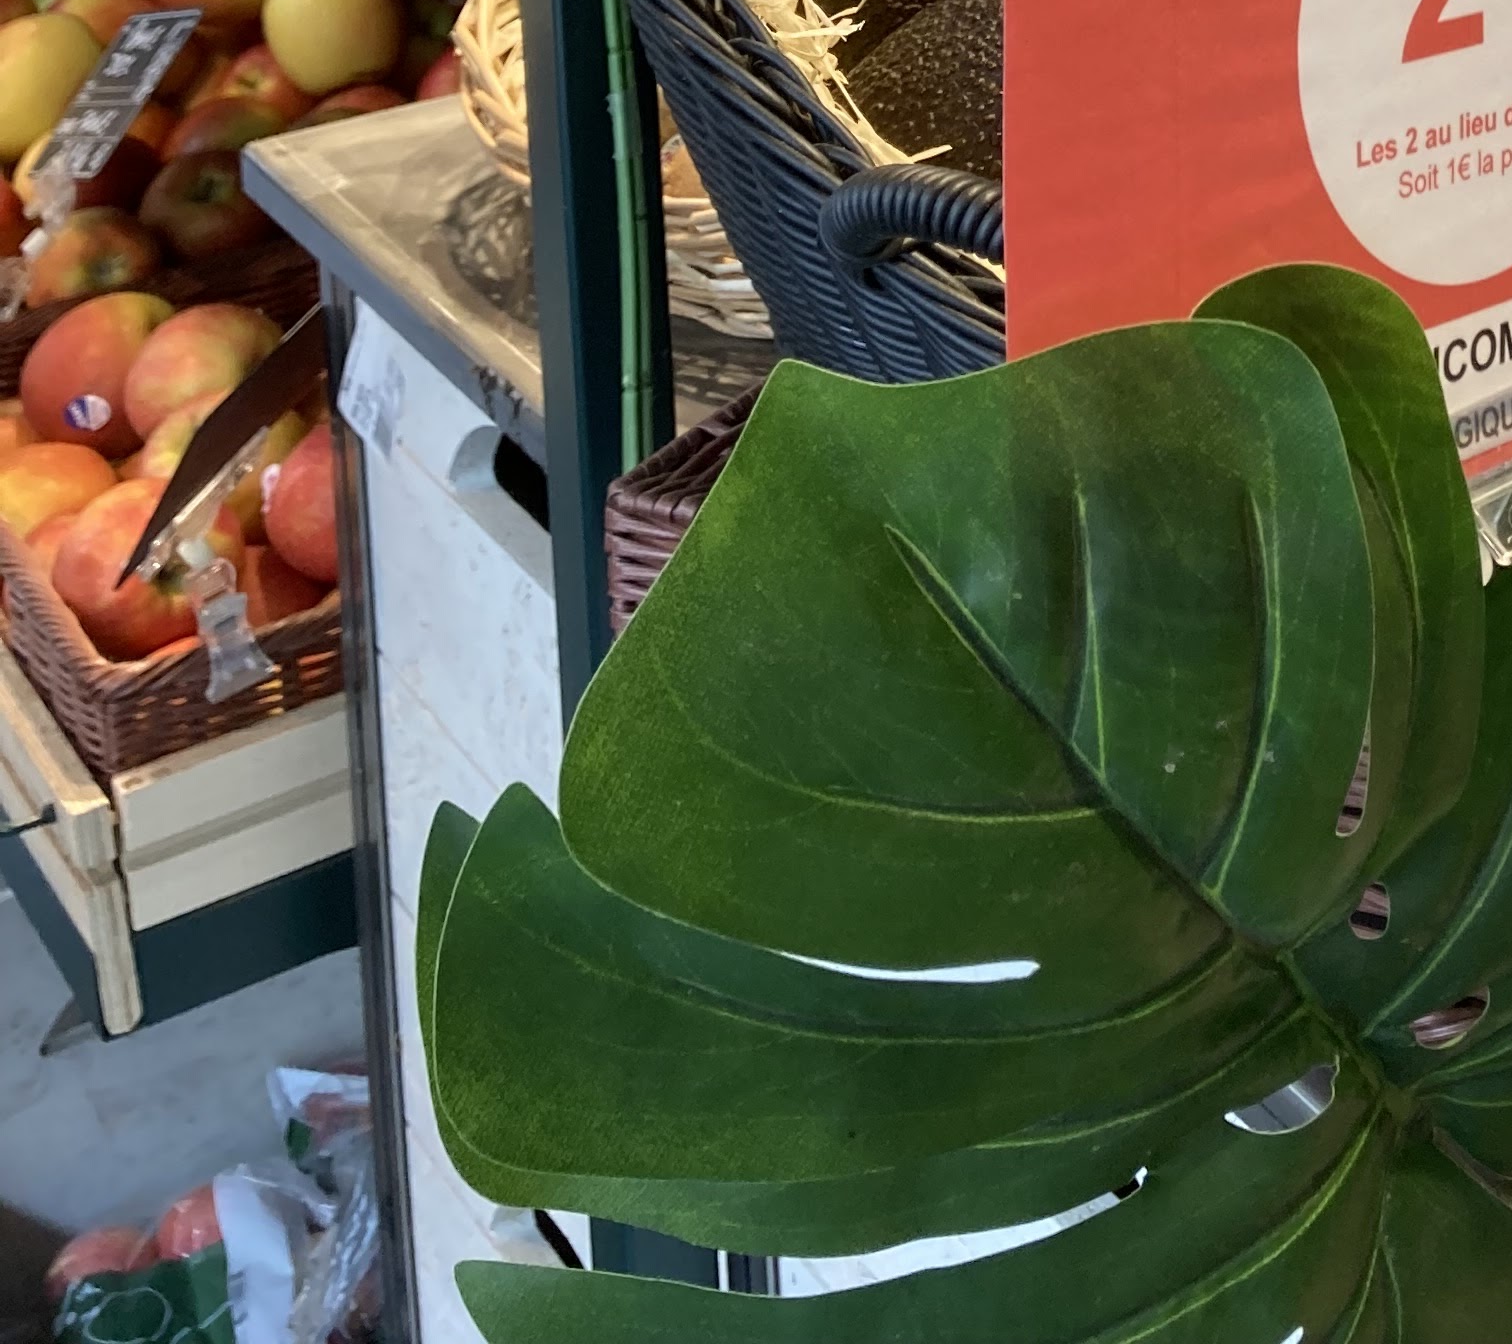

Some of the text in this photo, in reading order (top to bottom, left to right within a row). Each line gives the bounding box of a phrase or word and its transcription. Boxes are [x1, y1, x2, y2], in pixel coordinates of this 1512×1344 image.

[1356, 138, 1399, 170] Les
[1405, 126, 1419, 156] 2
[1424, 122, 1452, 151] au
[1458, 110, 1498, 141] lieu
[1398, 162, 1440, 200] Soit
[1446, 152, 1472, 186] 1€
[1477, 148, 1495, 178] la
